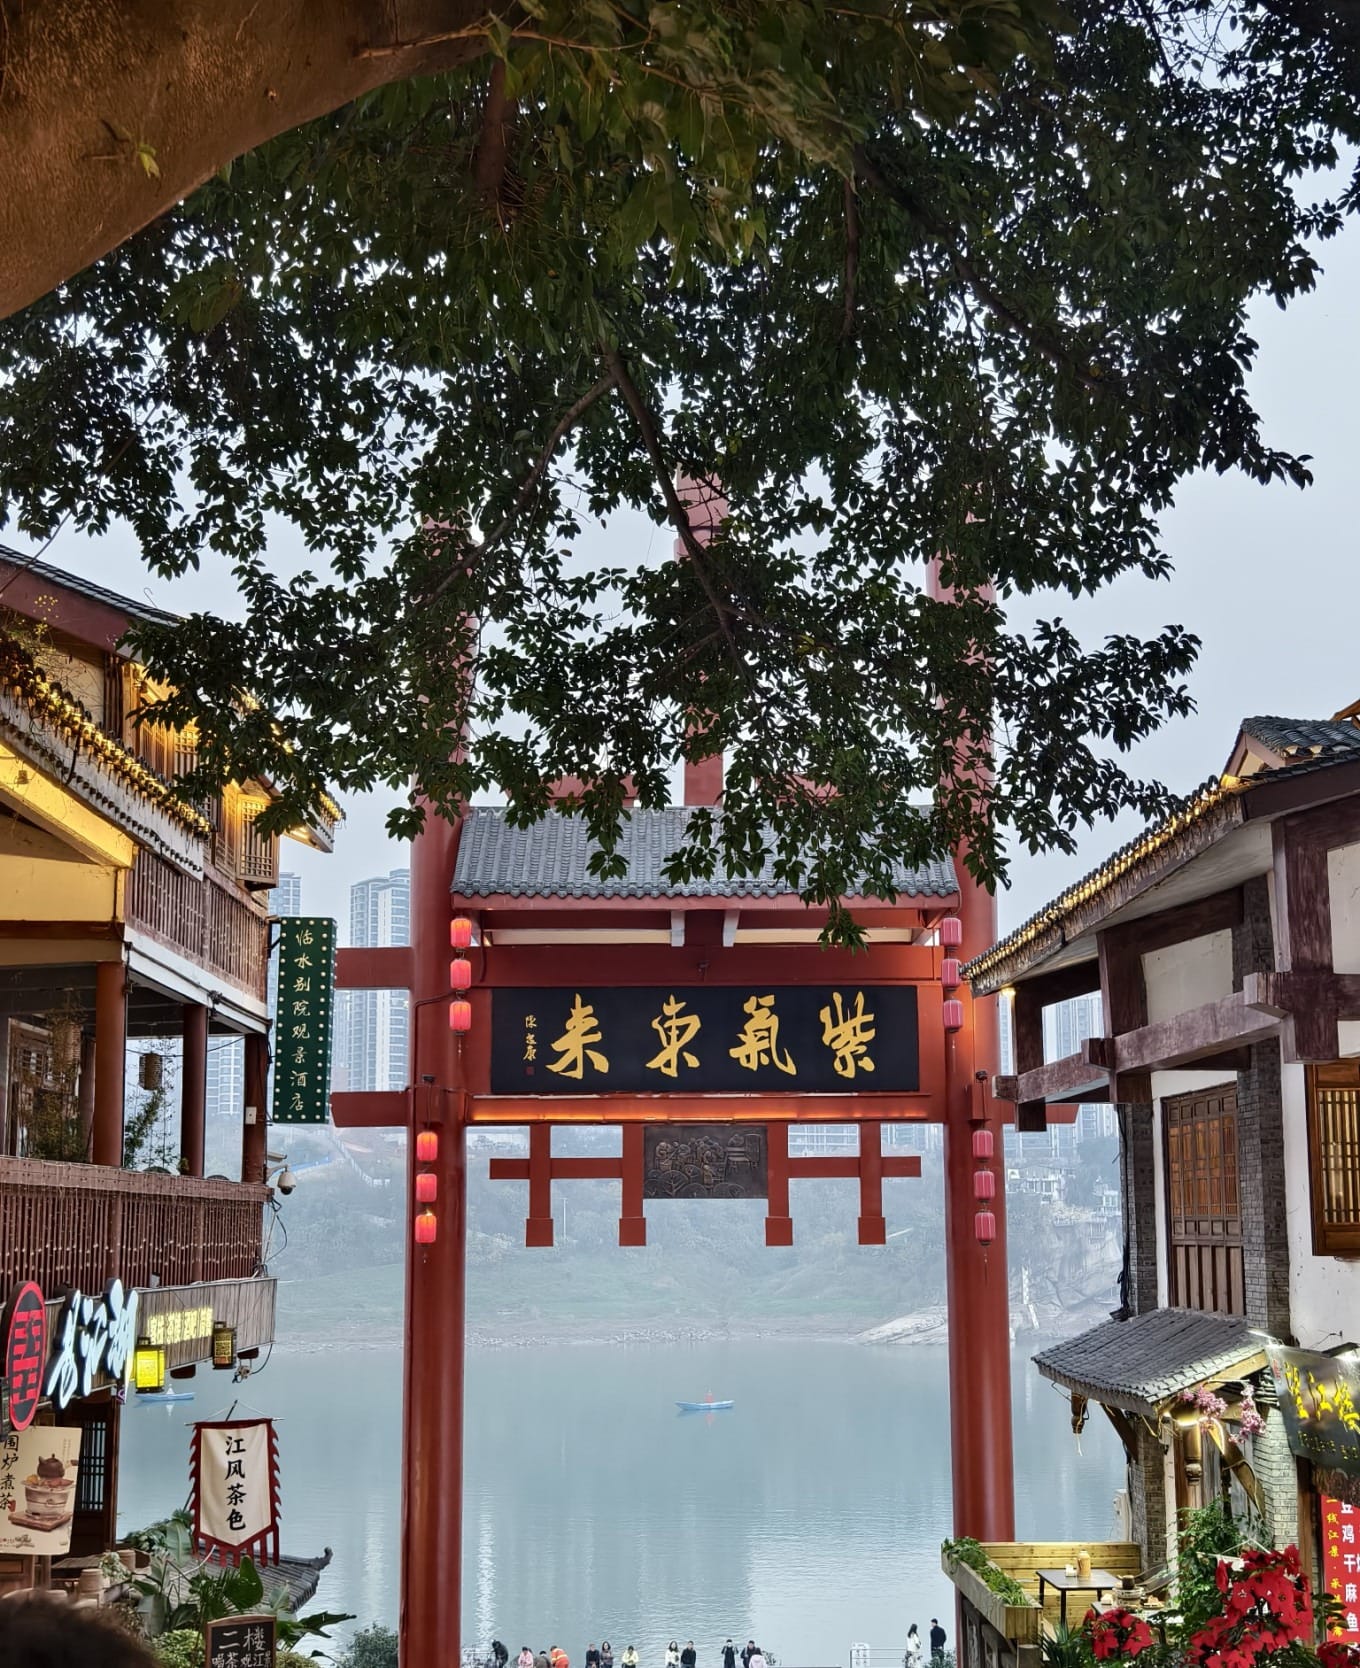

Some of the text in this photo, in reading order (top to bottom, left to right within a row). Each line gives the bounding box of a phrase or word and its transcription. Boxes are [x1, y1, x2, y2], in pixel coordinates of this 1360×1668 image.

[289, 929, 314, 1111] 临水别院观景酒店
[0, 1434, 19, 1511] 围炉煮茶
[225, 1436, 246, 1531] 江风茶色
[218, 1625, 266, 1652] 二楼
